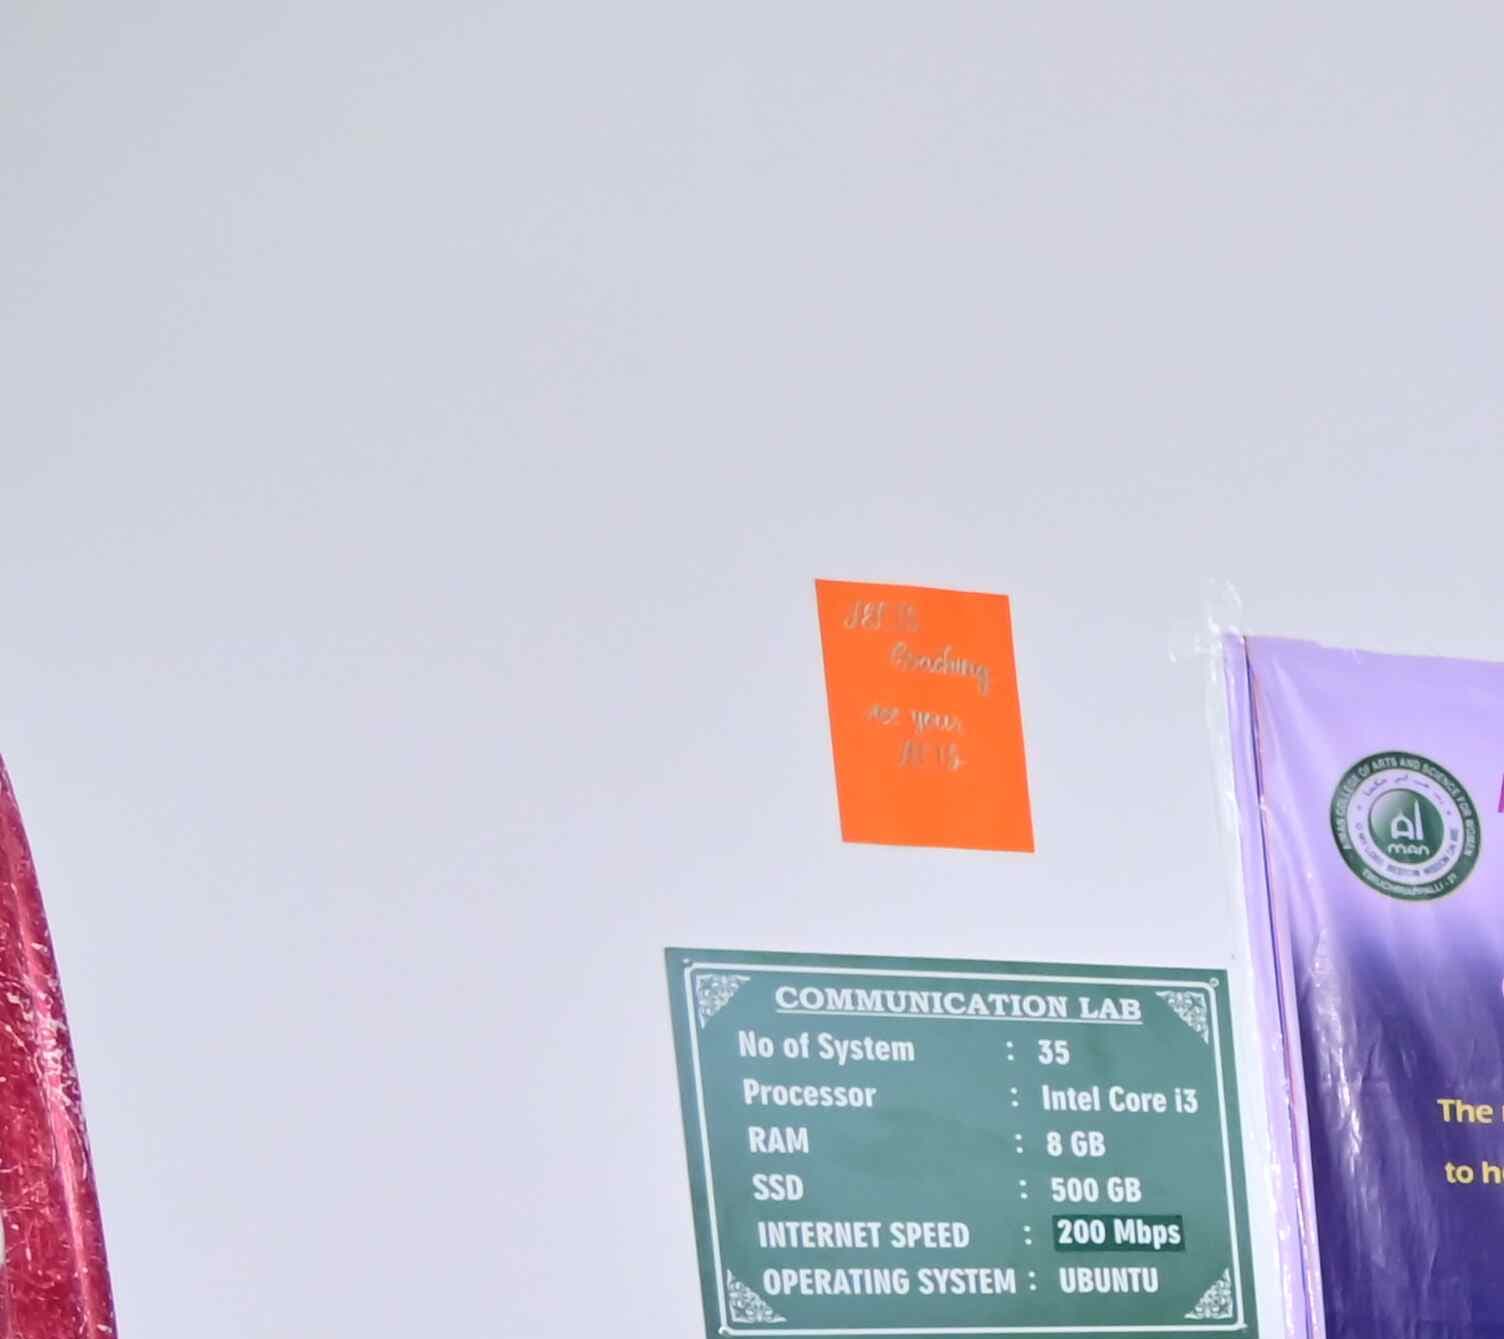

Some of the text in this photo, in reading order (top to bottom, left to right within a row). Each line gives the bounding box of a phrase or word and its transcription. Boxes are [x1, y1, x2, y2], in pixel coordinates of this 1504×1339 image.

[775, 986, 1143, 1021] COMMUNICATION LAB
[738, 1033, 1070, 1065] No of System 35
[744, 1079, 1199, 1114] Processor Intel Core i3
[1437, 1097, 1494, 1127] The
[748, 1128, 1106, 1157] RAM 8 GB
[1444, 1159, 1474, 1185] to
[753, 1175, 1143, 1201] SSD 500 GB
[757, 1220, 1182, 1250] INTERNET SPEED 200 Mbps
[763, 1267, 1160, 1295] OPERATING SYSTEM UBUNTU
